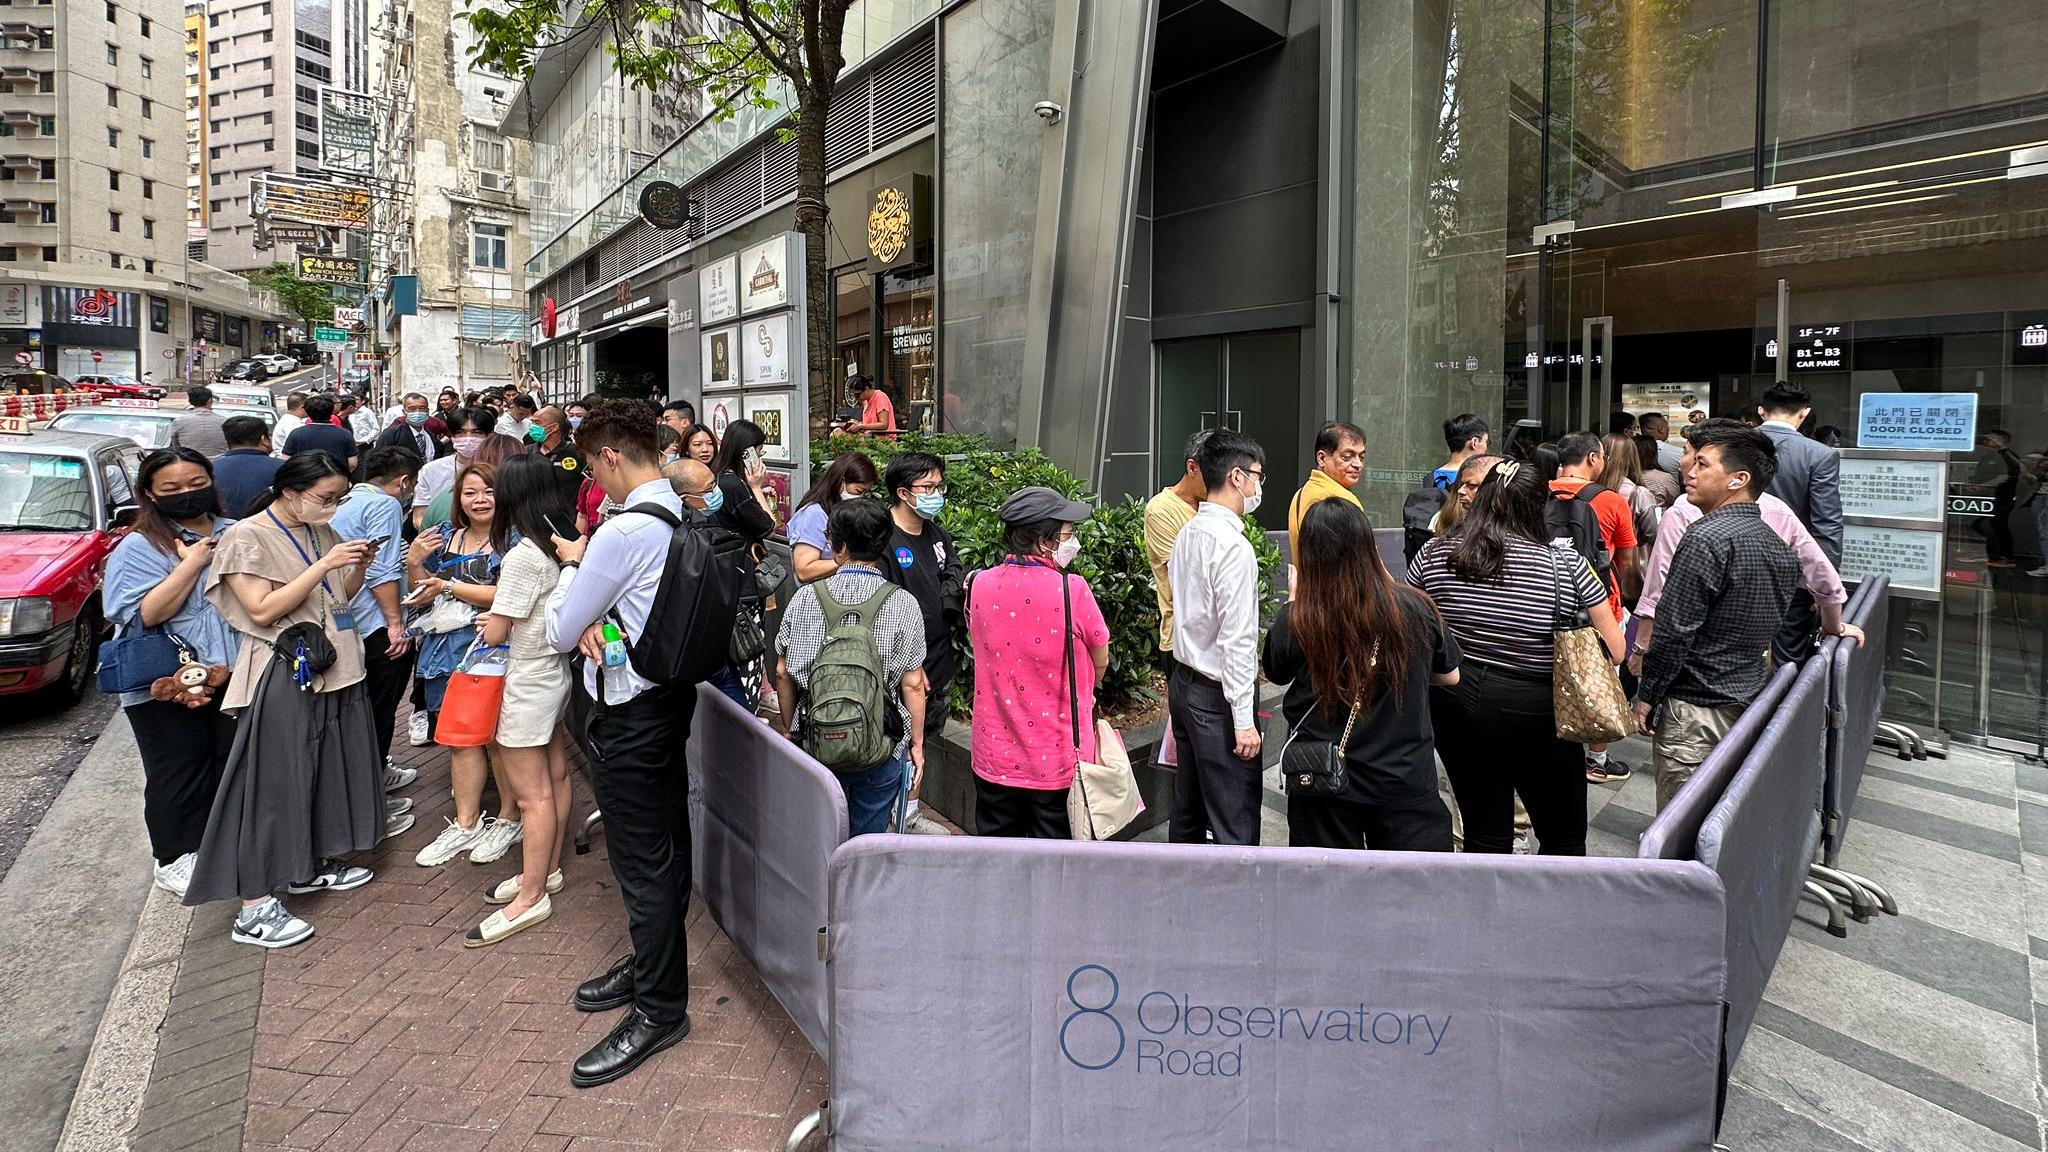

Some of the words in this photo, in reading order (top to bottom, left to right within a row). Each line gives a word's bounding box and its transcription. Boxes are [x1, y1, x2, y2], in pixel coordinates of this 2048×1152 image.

[1799, 328, 1813, 337] 1F
[1825, 327, 1840, 336] 7F
[892, 332, 932, 349] BREWING
[1814, 339, 1823, 347] &
[1796, 349, 1812, 358] B1
[1824, 348, 1840, 357] B3
[1875, 407, 1959, 417] 此門已關閉
[1866, 416, 1967, 426] 請使用其他入口
[1909, 426, 1962, 435] CLOSED
[1060, 964, 1125, 1070] 8
[1137, 991, 1452, 1056] Observatory
[1136, 1039, 1242, 1077] Road
